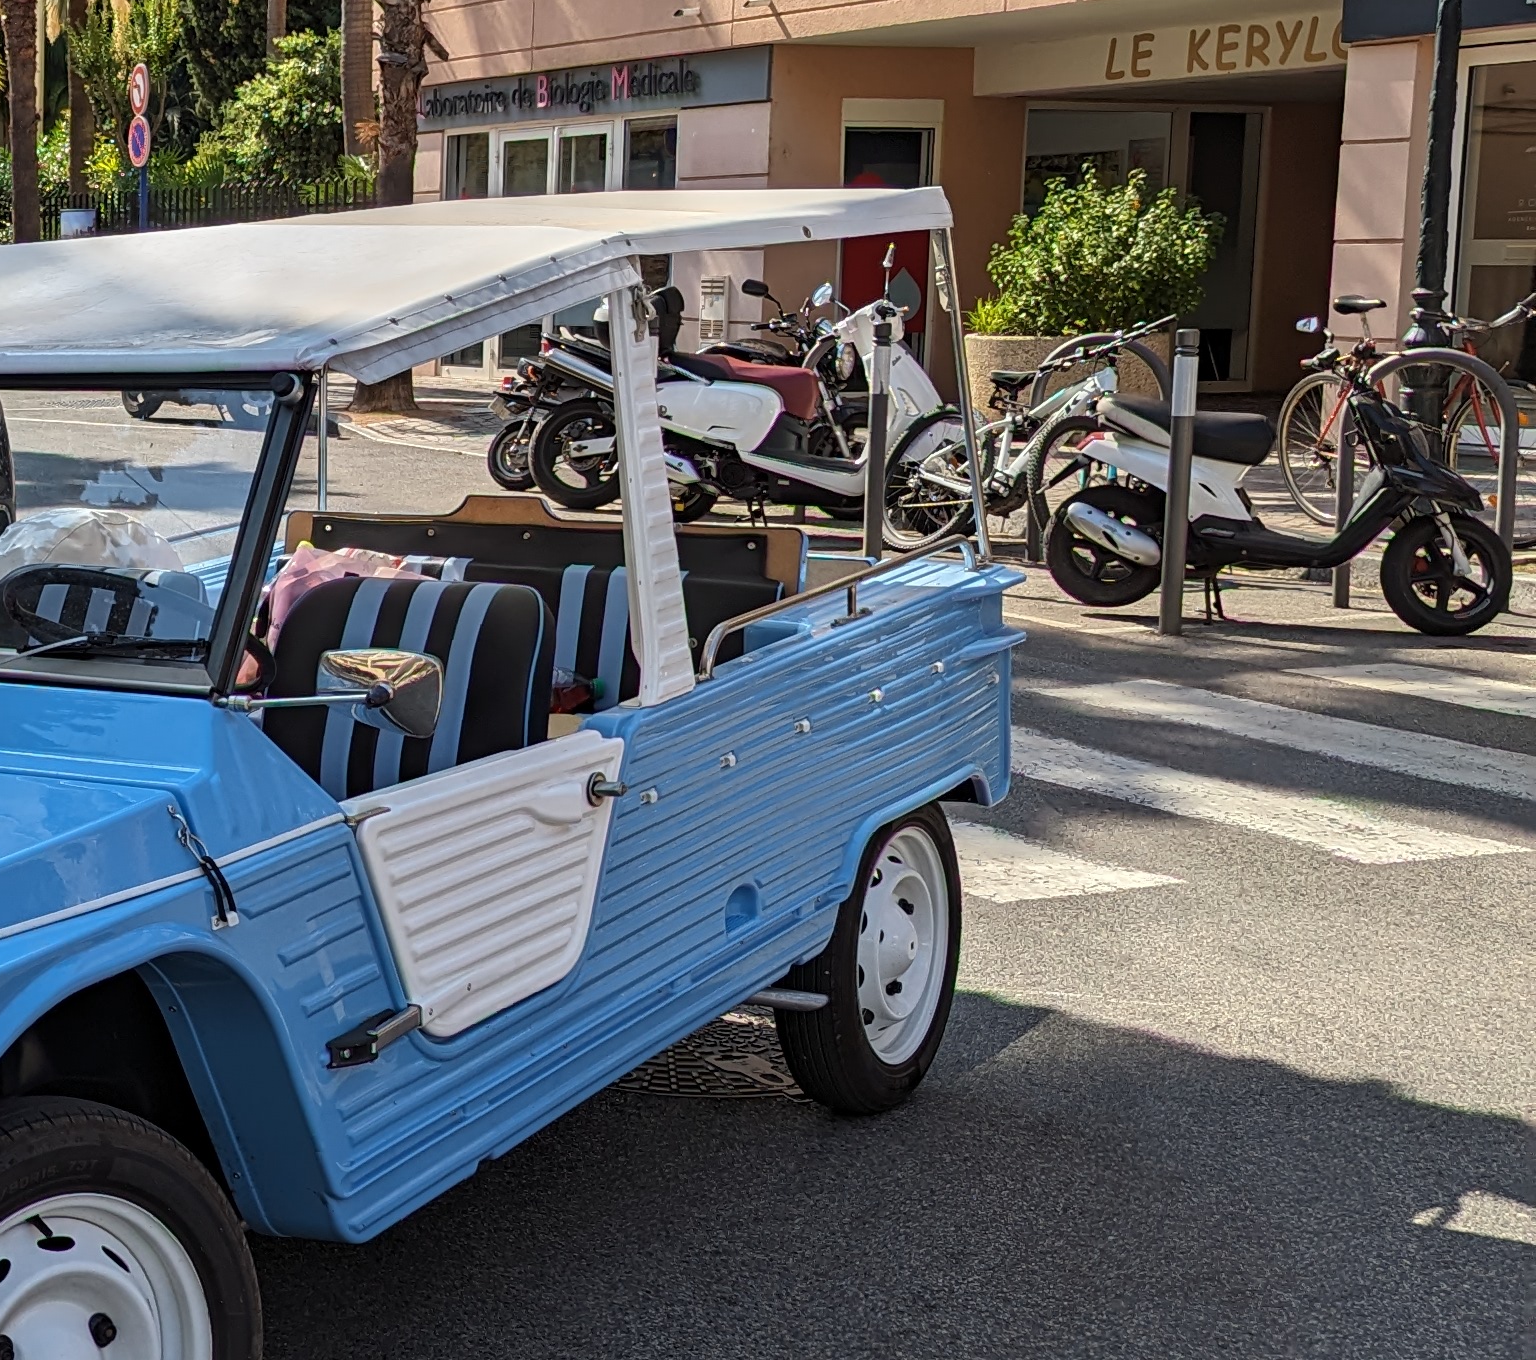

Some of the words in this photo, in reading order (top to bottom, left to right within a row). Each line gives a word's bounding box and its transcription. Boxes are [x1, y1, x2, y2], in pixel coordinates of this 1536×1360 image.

[1105, 33, 1155, 80] LE
[417, 84, 507, 120] Laboratoire
[512, 78, 533, 110] de
[536, 71, 607, 115] Biologie
[611, 59, 699, 101] Médicale
